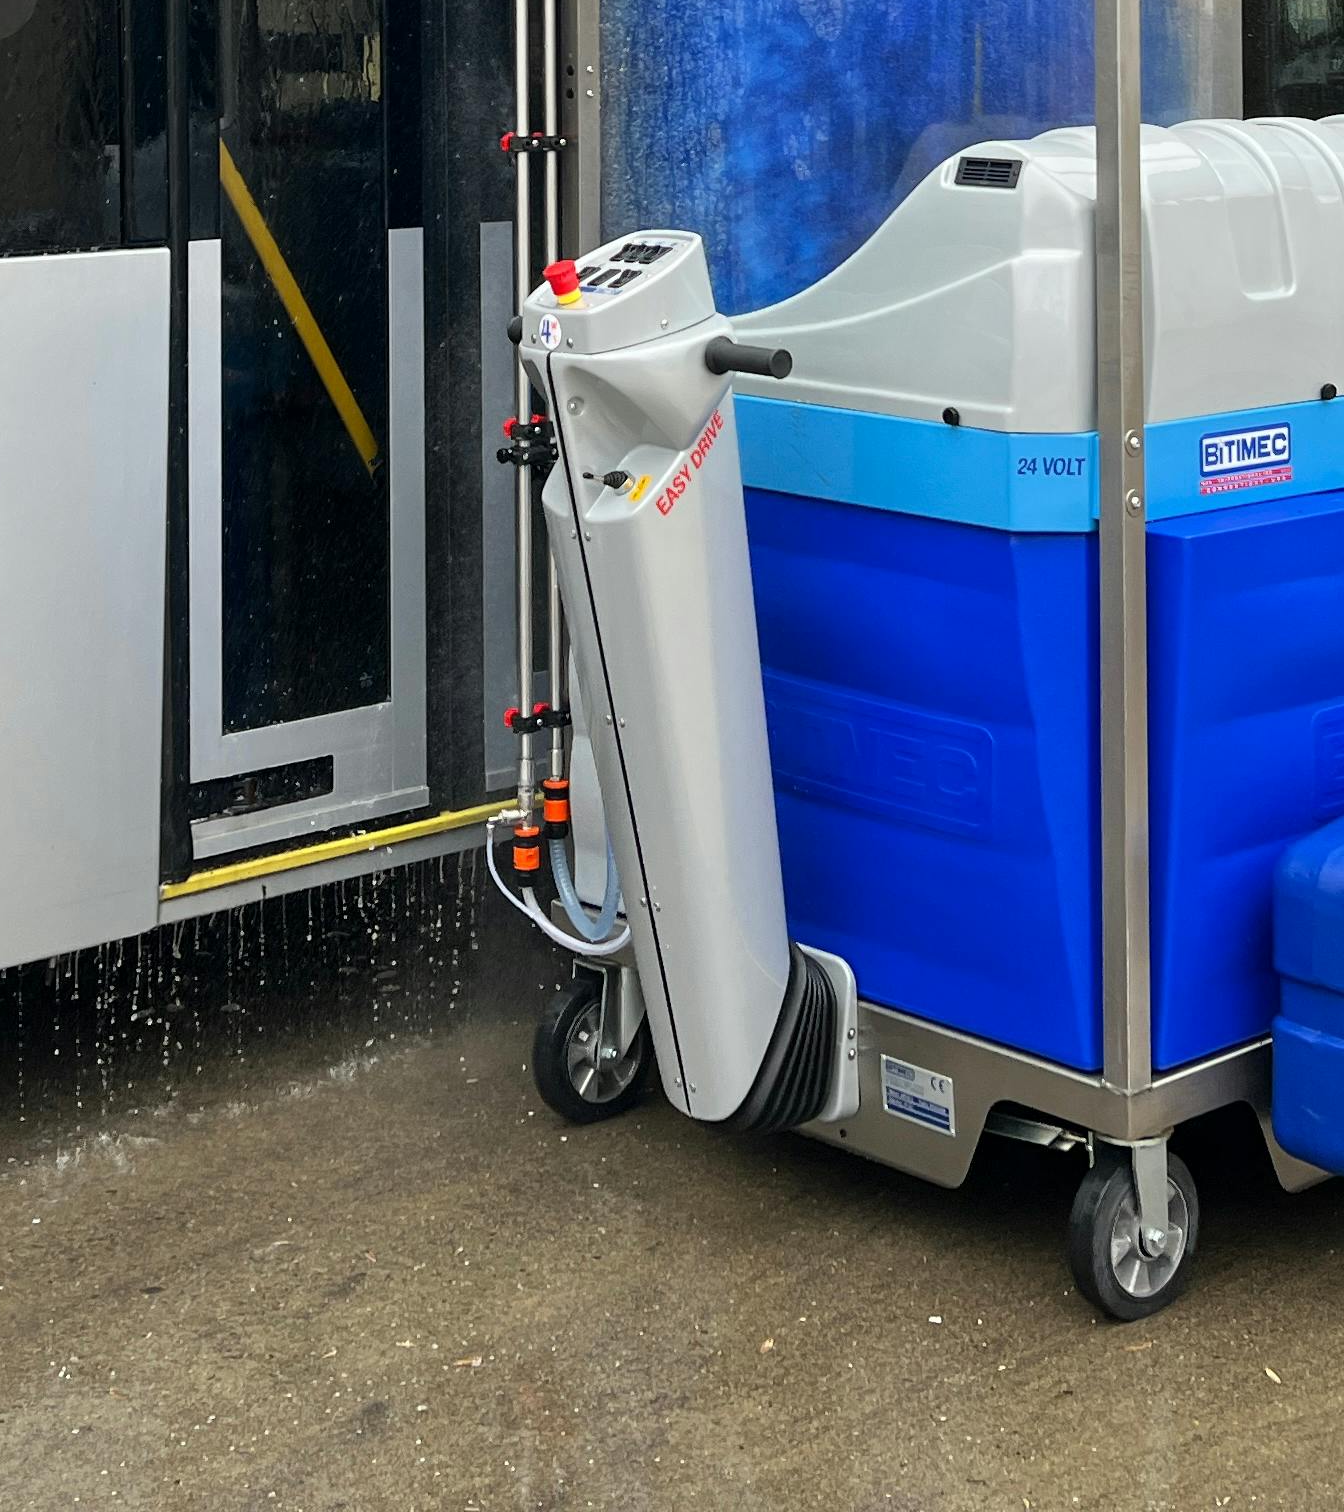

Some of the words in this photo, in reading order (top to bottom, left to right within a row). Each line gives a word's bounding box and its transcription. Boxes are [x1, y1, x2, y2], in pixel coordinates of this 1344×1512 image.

[655, 464, 693, 517] EASY
[689, 408, 726, 470] DRIVE
[1017, 457, 1038, 476] 24
[1043, 457, 1086, 476] VOLT
